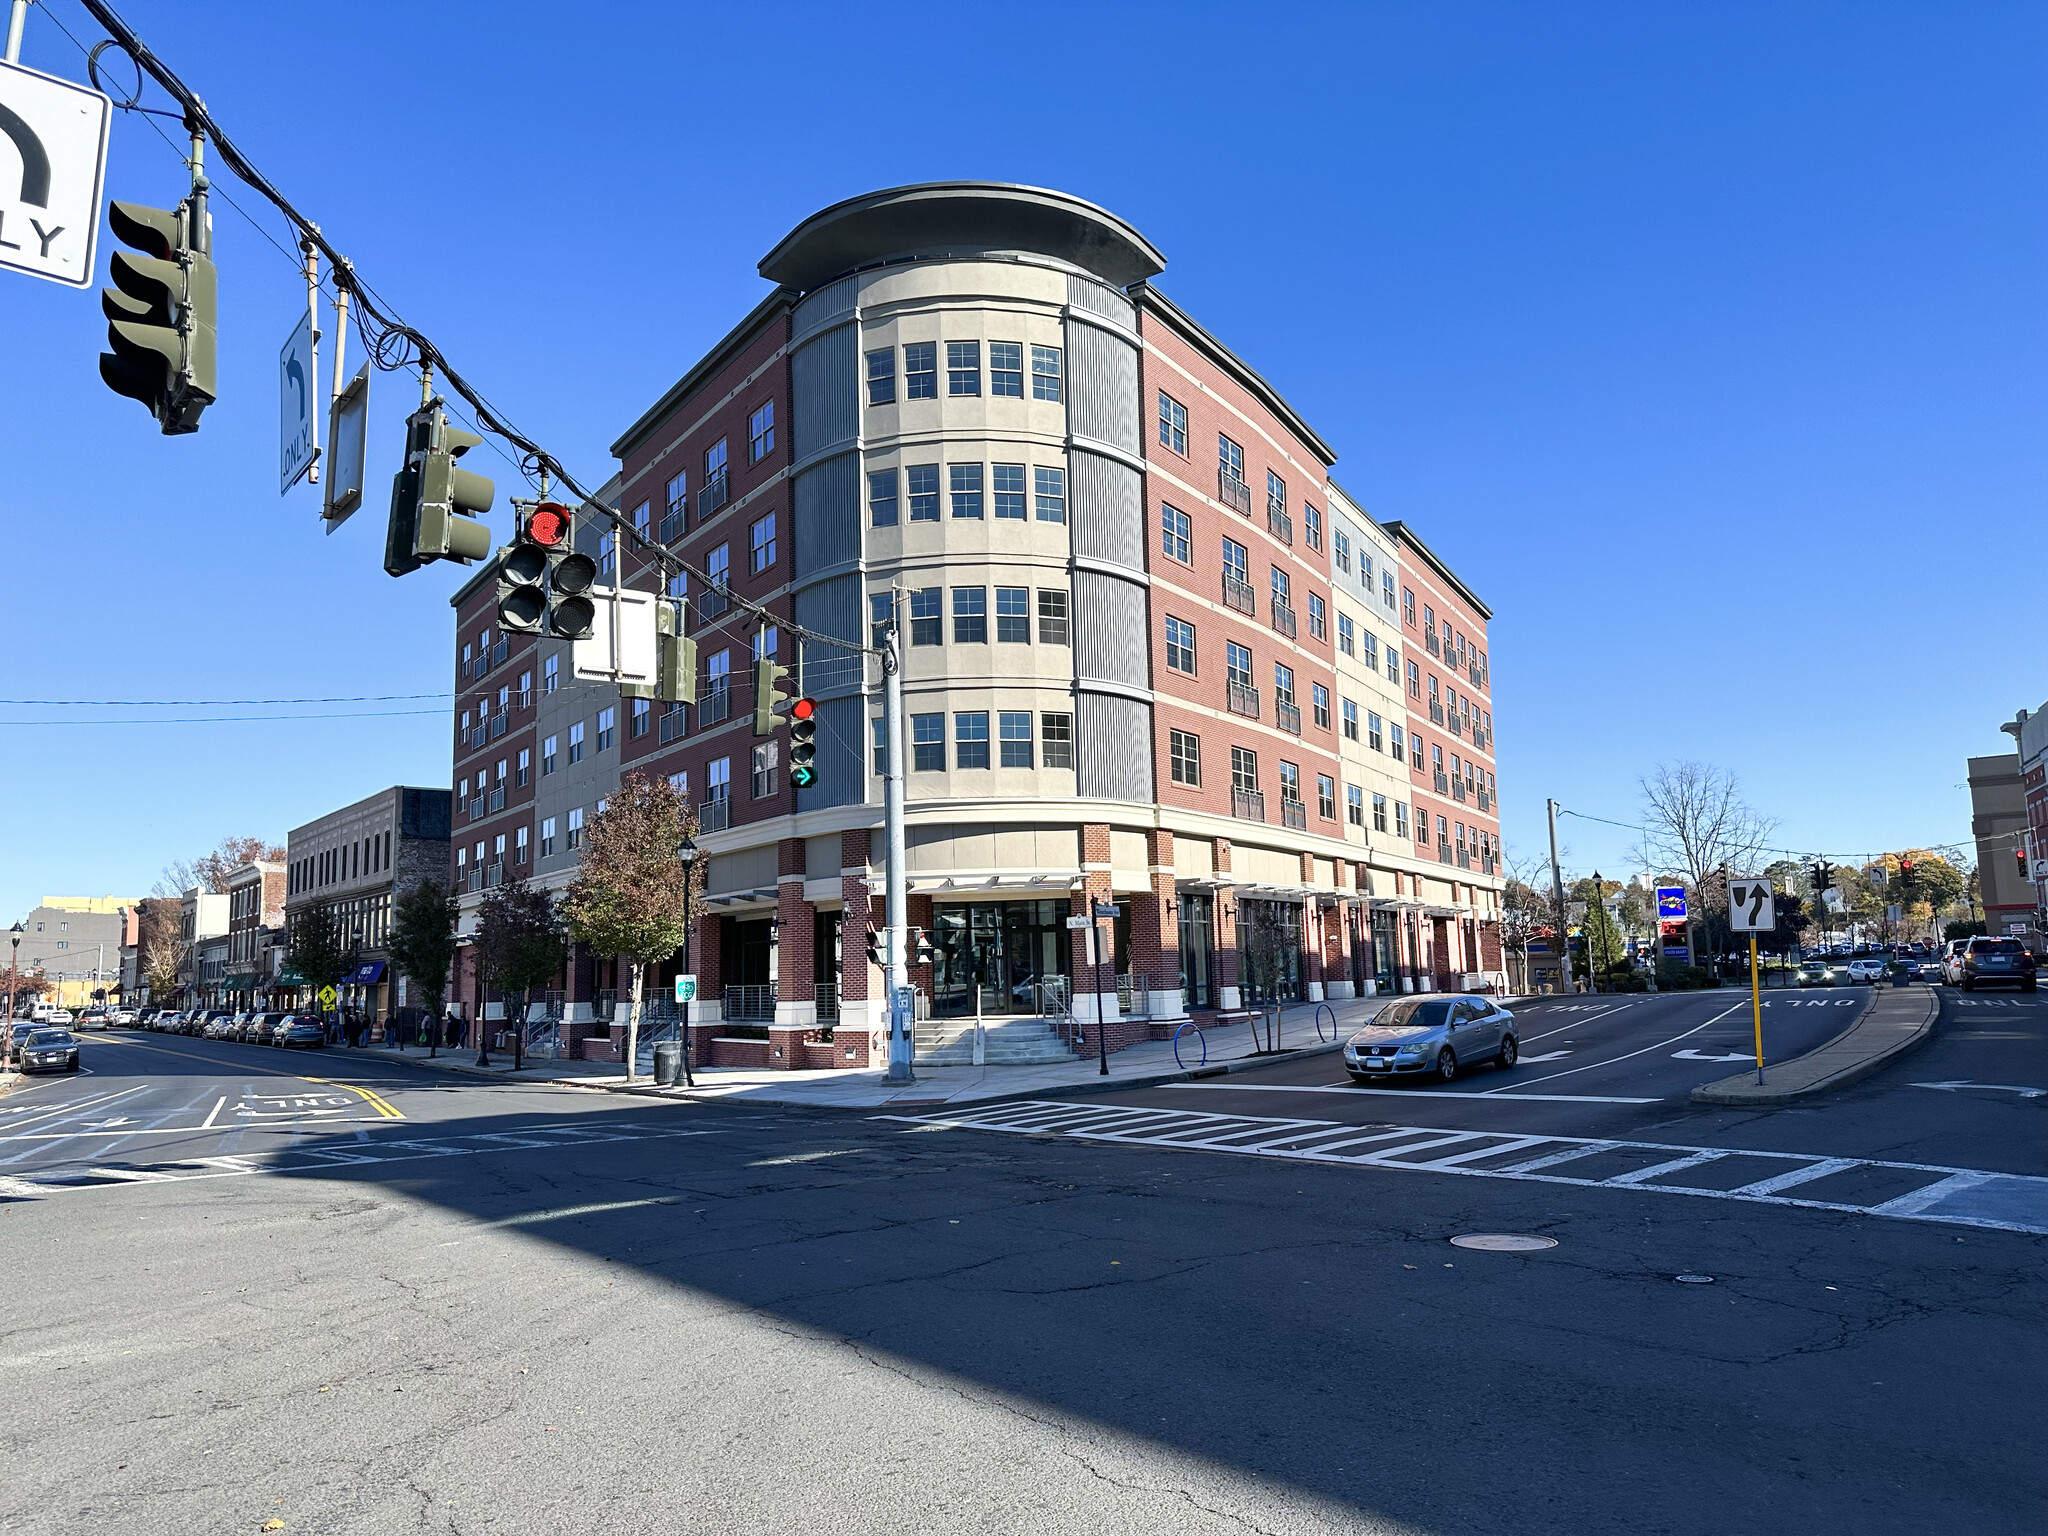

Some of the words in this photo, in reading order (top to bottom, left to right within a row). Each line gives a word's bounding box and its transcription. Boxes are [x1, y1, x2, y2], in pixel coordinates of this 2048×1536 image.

[285, 422, 308, 475] ONLY
[1759, 999, 1855, 1007] ONLY
[229, 1097, 353, 1111] ONLY
